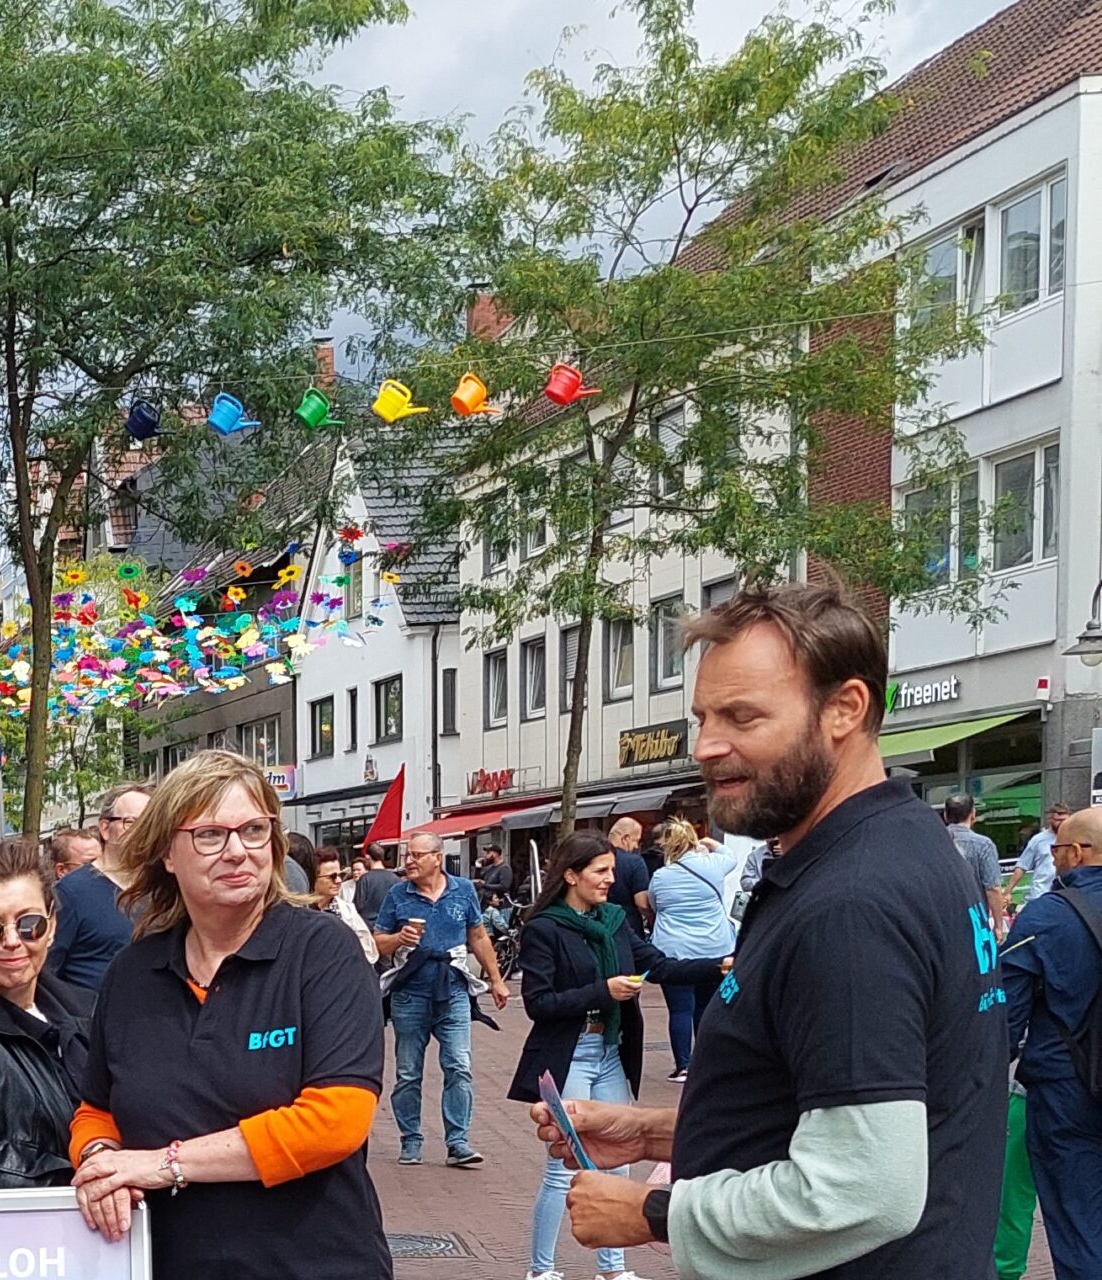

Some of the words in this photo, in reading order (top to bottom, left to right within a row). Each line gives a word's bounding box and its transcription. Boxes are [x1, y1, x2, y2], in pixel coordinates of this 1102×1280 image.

[900, 675, 959, 708] freenet
[633, 728, 680, 763] Tchibo
[248, 1026, 297, 1050] BfGT
